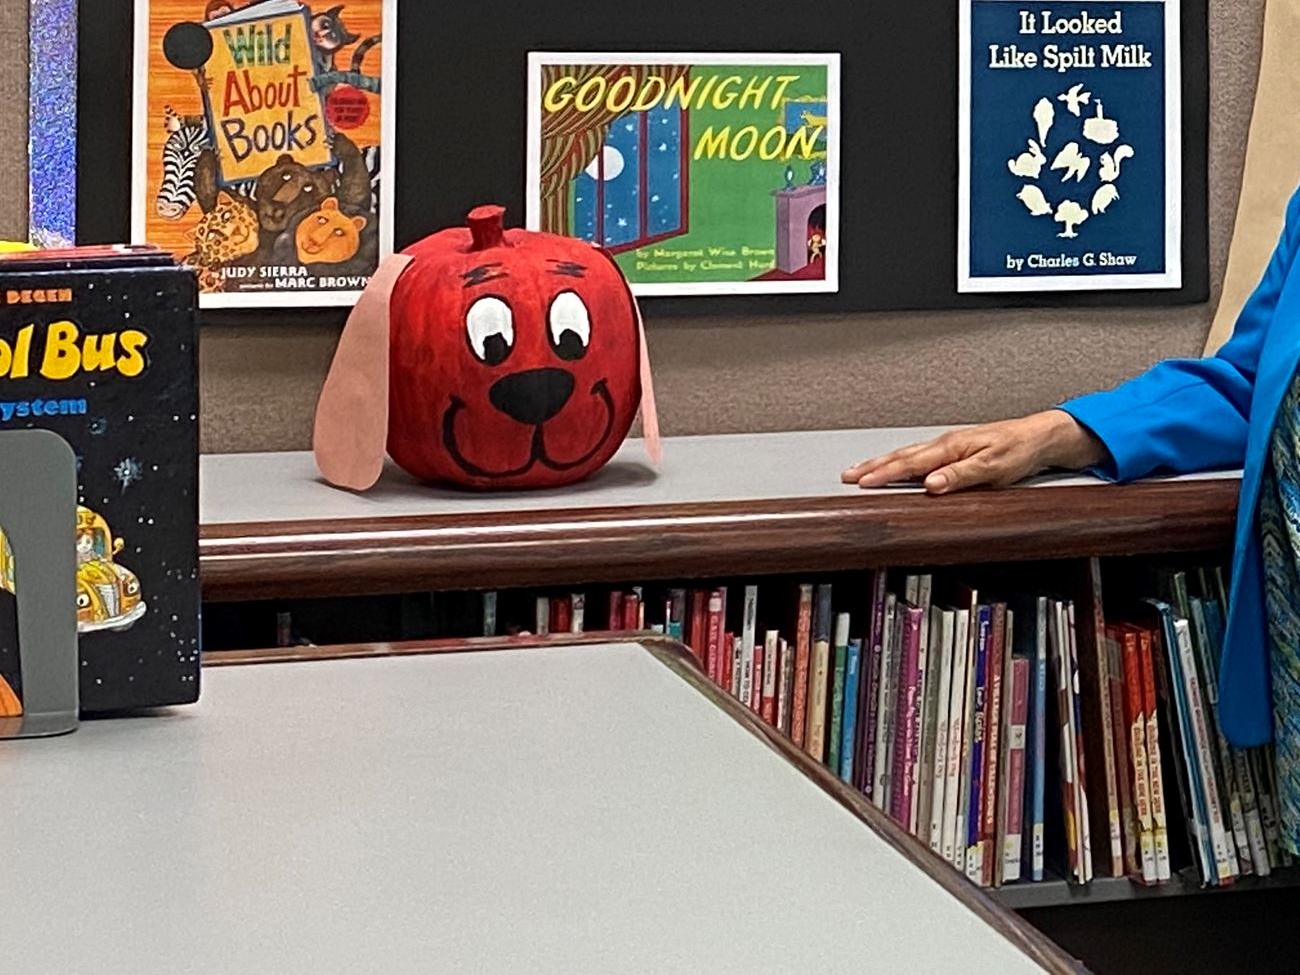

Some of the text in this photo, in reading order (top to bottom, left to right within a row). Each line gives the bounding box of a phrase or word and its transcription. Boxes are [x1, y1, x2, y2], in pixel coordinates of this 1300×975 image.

[1019, 10, 1122, 34] It Looked
[222, 22, 292, 67] Wild
[989, 44, 1152, 73] Like Spilt Milk
[223, 65, 308, 117] About
[543, 75, 801, 113] GOODNIGHT
[220, 111, 319, 163] Books
[694, 124, 824, 161] MOON
[221, 266, 308, 279] JUDY SIERRA
[1006, 254, 1025, 270] by
[1027, 254, 1080, 268] Charles
[1099, 252, 1137, 267] Shaw
[275, 277, 316, 288] MARC
[40, 320, 148, 380] Bus
